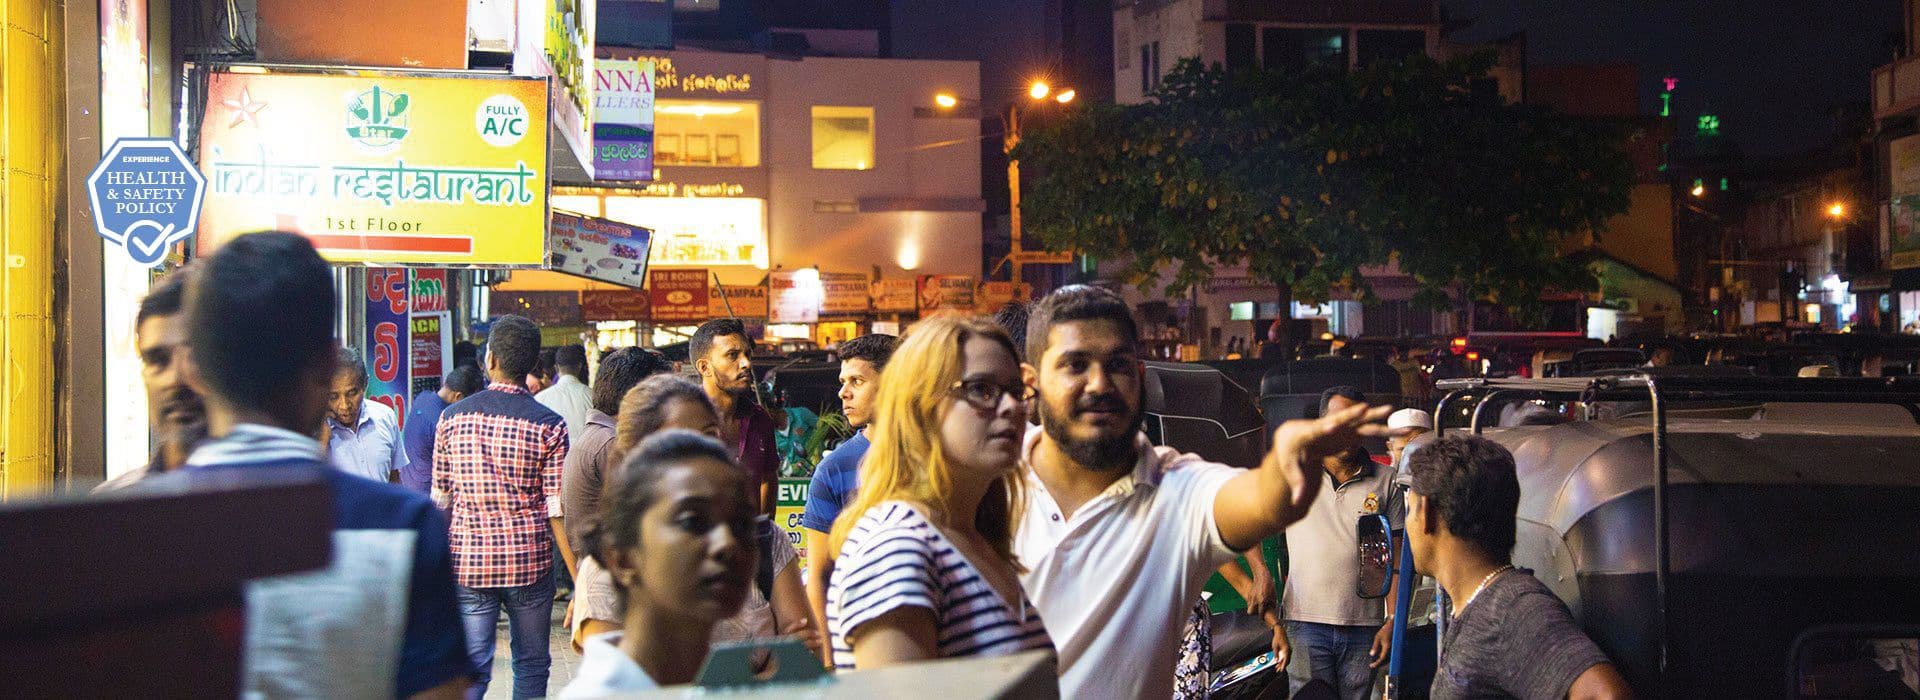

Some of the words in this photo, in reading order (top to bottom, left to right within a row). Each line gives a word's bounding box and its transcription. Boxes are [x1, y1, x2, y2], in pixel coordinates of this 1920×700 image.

[595, 69, 650, 93] NNA
[486, 105, 520, 115] FULLY
[483, 118, 522, 136] A/C
[214, 143, 320, 196] indian
[332, 160, 535, 206] restaurant
[327, 217, 355, 230] 1st
[367, 217, 423, 232] Floor
